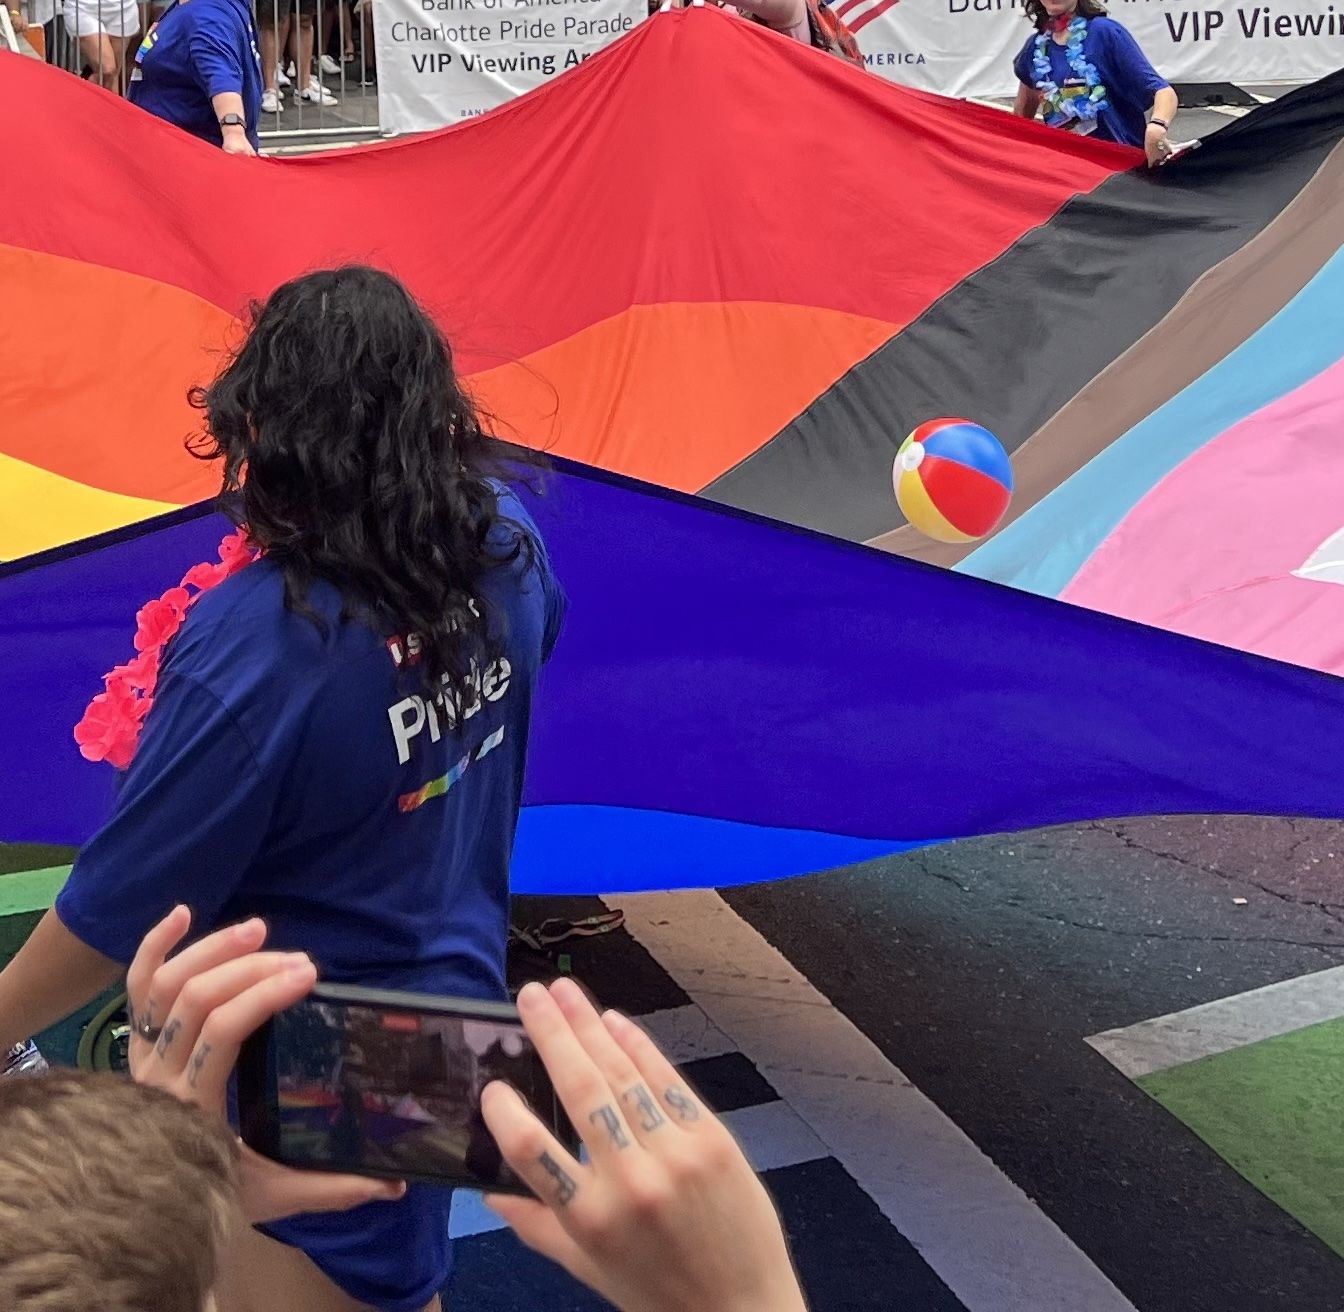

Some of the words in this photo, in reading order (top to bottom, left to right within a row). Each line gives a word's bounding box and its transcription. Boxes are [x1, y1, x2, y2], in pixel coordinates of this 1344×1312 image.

[391, 17, 491, 43] Charlotte
[500, 19, 556, 41] Pride
[564, 12, 634, 37] Parade
[1164, 10, 1225, 43] VIP
[411, 53, 453, 74] VIP
[461, 51, 556, 76] Viewing
